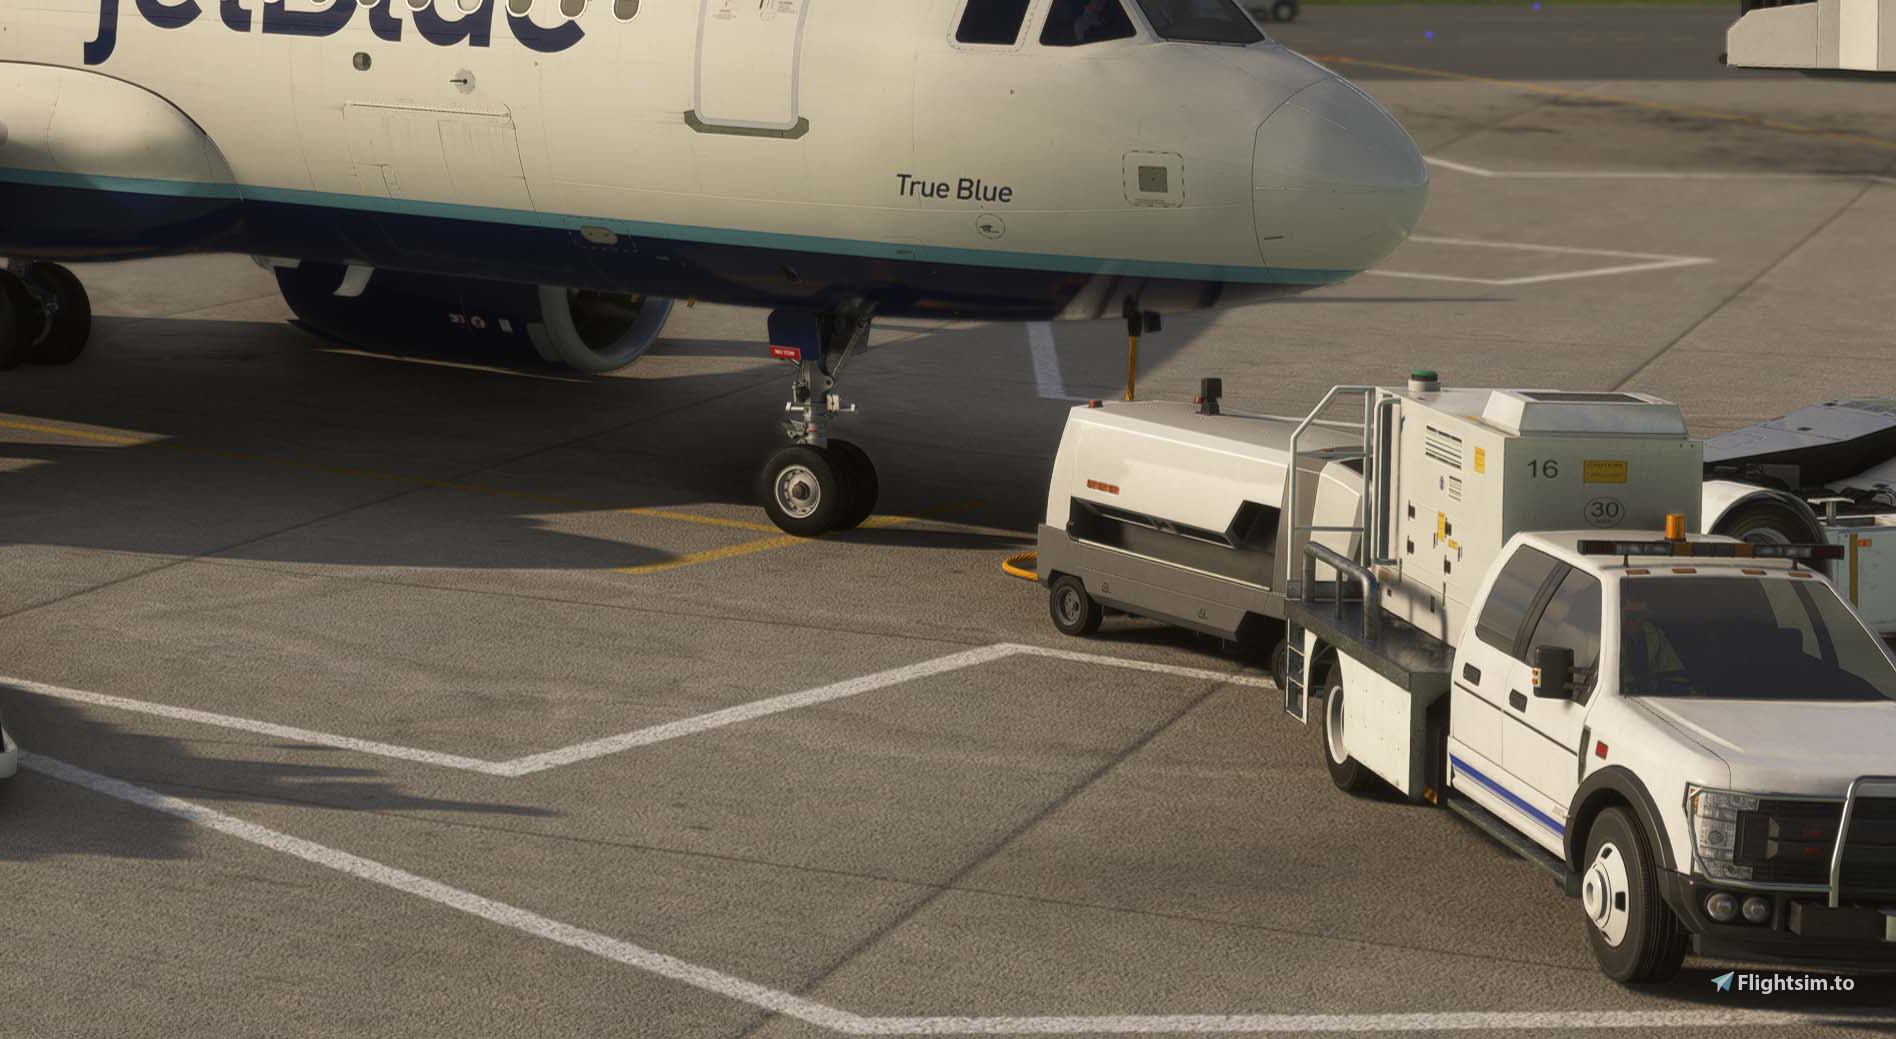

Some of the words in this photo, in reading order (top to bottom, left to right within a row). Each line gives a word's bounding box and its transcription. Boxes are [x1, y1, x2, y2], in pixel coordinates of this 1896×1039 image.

[896, 173, 951, 199] True
[956, 178, 1013, 203] Blue
[1527, 459, 1559, 479] 16
[1590, 501, 1620, 518] 30
